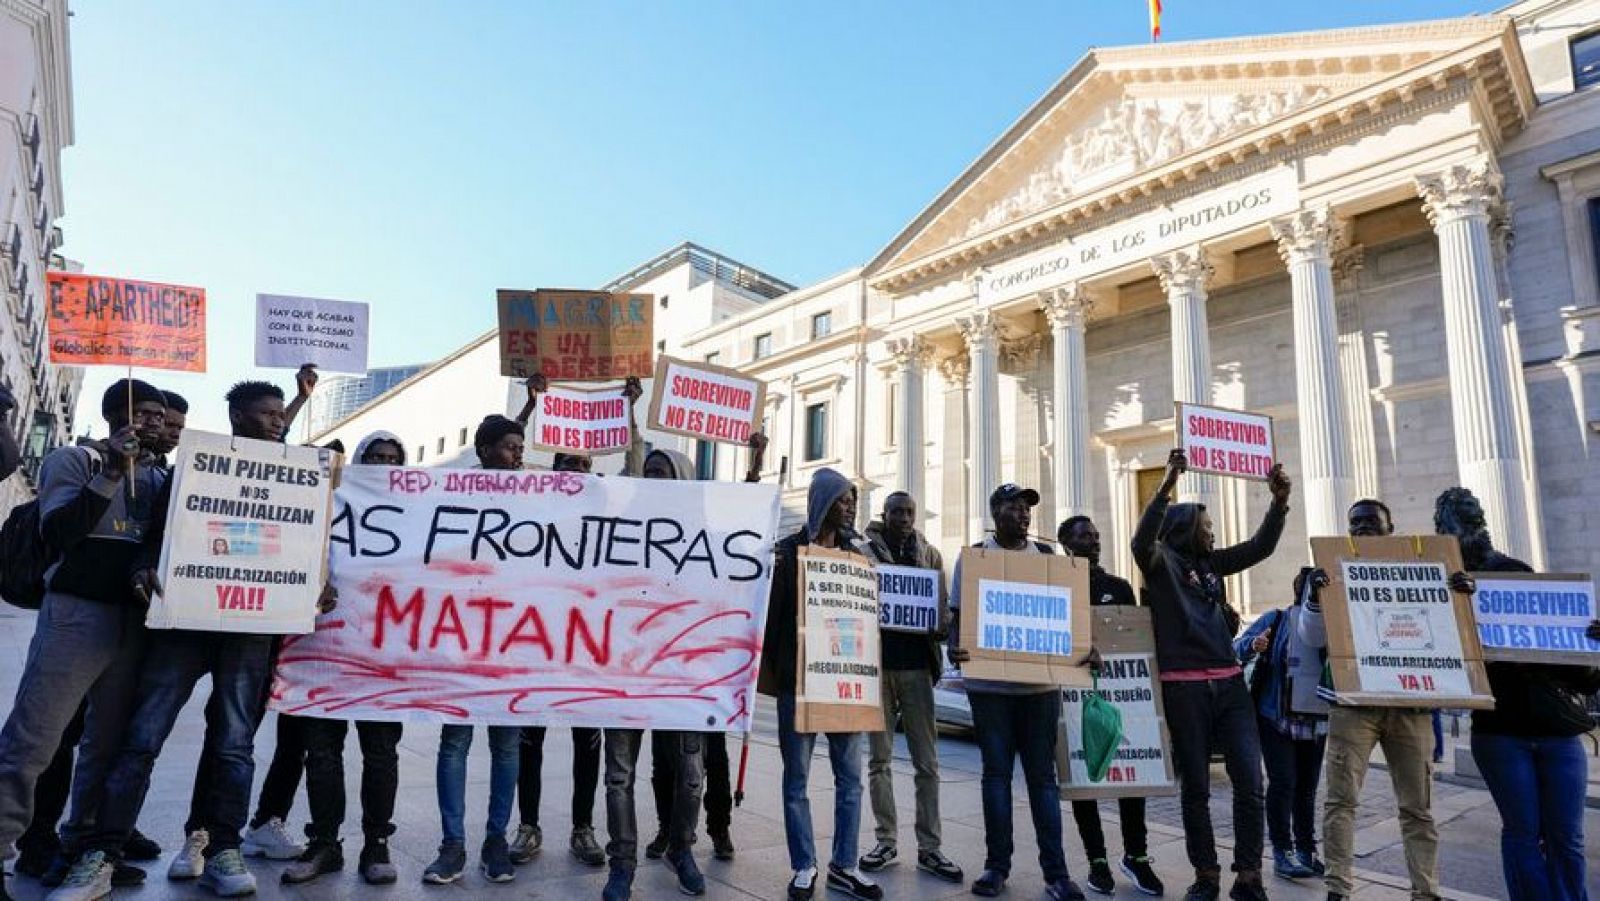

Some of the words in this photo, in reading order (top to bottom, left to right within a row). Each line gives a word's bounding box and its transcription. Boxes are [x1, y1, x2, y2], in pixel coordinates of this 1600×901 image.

[990, 257, 1070, 292] CONGRESO
[1080, 243, 1102, 264] DE
[1112, 230, 1146, 253] LOS
[1158, 188, 1272, 236] DIPUTADOS
[269, 308, 290, 317] HAY
[292, 309, 313, 319] QUE
[317, 312, 354, 323] ACABAR
[268, 321, 290, 331] CON
[292, 323, 304, 332] EL
[307, 324, 353, 337] RACISMO
[268, 336, 349, 350] INSTITUCIONAL
[508, 330, 538, 355] ES
[672, 374, 751, 412] SOBREVIVIR
[543, 395, 624, 418] SOBREVIVIR
[665, 405, 685, 428] NO
[687, 411, 706, 432] ES
[707, 415, 750, 443] DELITO
[1189, 415, 1267, 446] SOBREVIVIR
[541, 424, 561, 446] NO
[564, 427, 580, 447] ES
[583, 427, 628, 449] DELITO
[193, 453, 231, 475] SIN
[235, 459, 320, 488] PAPELES
[1189, 445, 1207, 468] NO
[1211, 448, 1226, 470] ES
[1229, 450, 1272, 477] DELITO
[240, 485, 270, 500] NOS
[389, 470, 431, 494] RED
[185, 494, 315, 525] CRIMINALIZAN
[423, 504, 764, 582] FRONTERAS
[173, 565, 307, 585] #REGULARIZACIÓN
[806, 560, 826, 574] ME
[1348, 565, 1442, 581] SOBREVIVIR
[216, 585, 266, 612] YA!!
[807, 597, 820, 607] AL
[808, 581, 817, 592] A
[819, 581, 843, 594] SER
[846, 583, 876, 601] ILEGAL
[1348, 586, 1370, 603] NO
[1373, 587, 1393, 603] ES
[1396, 587, 1449, 604] DELITO
[985, 590, 1068, 621] SOBREVIVIR
[1478, 590, 1590, 617] SOBREVIVIR
[372, 584, 613, 665] MATAN
[893, 603, 937, 629] DELITO
[984, 624, 1002, 648] NO
[1006, 626, 1023, 649] ES
[1026, 628, 1071, 655] DELITO
[1479, 623, 1505, 646] NO
[1509, 624, 1532, 648] ES
[1101, 658, 1149, 680] ANTA
[1362, 656, 1462, 669] #REGULARIZACIÓN
[837, 682, 853, 699] YA
[1398, 674, 1420, 690] YA
[1062, 689, 1079, 703] NO
[1114, 687, 1152, 703] SUEÑO
